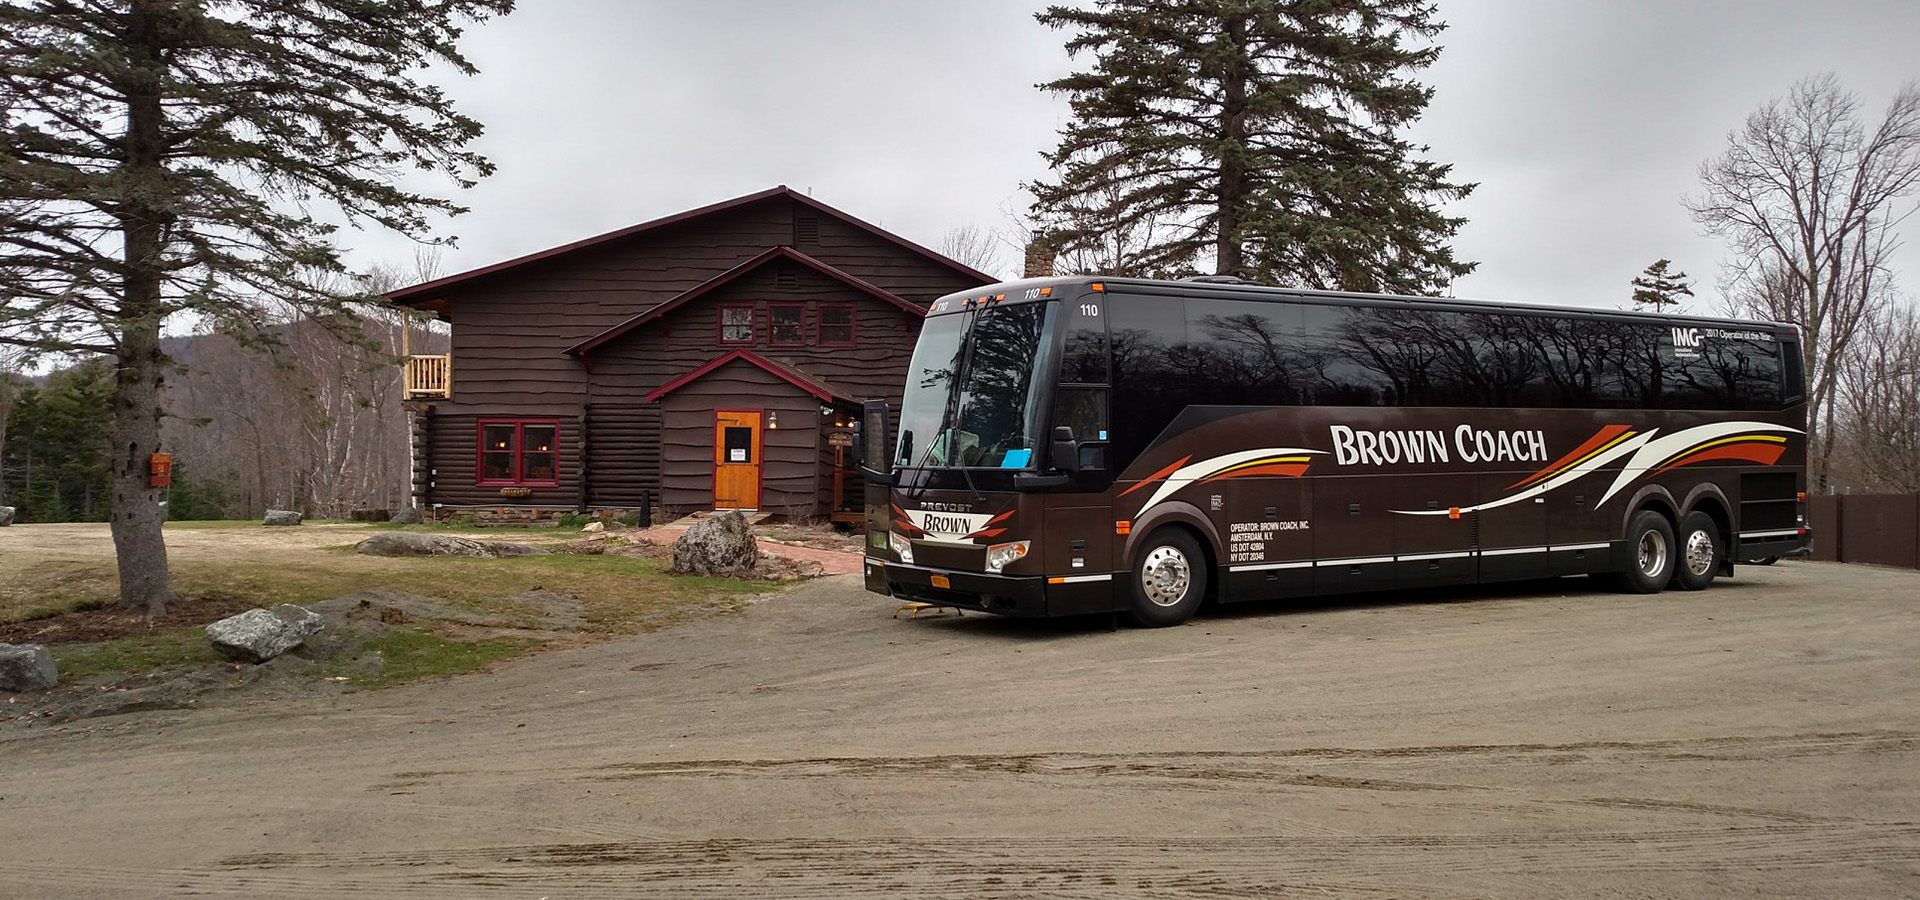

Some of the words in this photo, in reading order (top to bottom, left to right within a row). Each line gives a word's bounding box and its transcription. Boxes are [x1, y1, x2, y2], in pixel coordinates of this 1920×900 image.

[1025, 288, 1040, 299] 110
[936, 302, 949, 312] 110
[1081, 304, 1098, 316] 110
[1672, 328, 1704, 347] IMG
[1705, 329, 1718, 338] 2017
[1719, 330, 1743, 340] Operator
[1744, 331, 1750, 340] of
[1750, 331, 1759, 340] the
[1759, 332, 1774, 341] Year
[1329, 425, 1450, 466] BROWN
[1454, 424, 1548, 463] COACH
[920, 502, 973, 512] PREVOST
[923, 513, 971, 534] BROWN
[1230, 523, 1259, 532] OPERATOR:
[1260, 522, 1279, 531] BROWN
[1280, 521, 1299, 531] COACH,
[1300, 520, 1310, 529] INC.
[1230, 532, 1263, 542] AMSTERDAM,
[1264, 532, 1274, 540] N.Y.
[1230, 543, 1238, 552] US
[1239, 543, 1249, 551] DOT
[1230, 553, 1238, 562] NY
[1239, 553, 1249, 561] DOT
[1250, 552, 1264, 561] 20346
